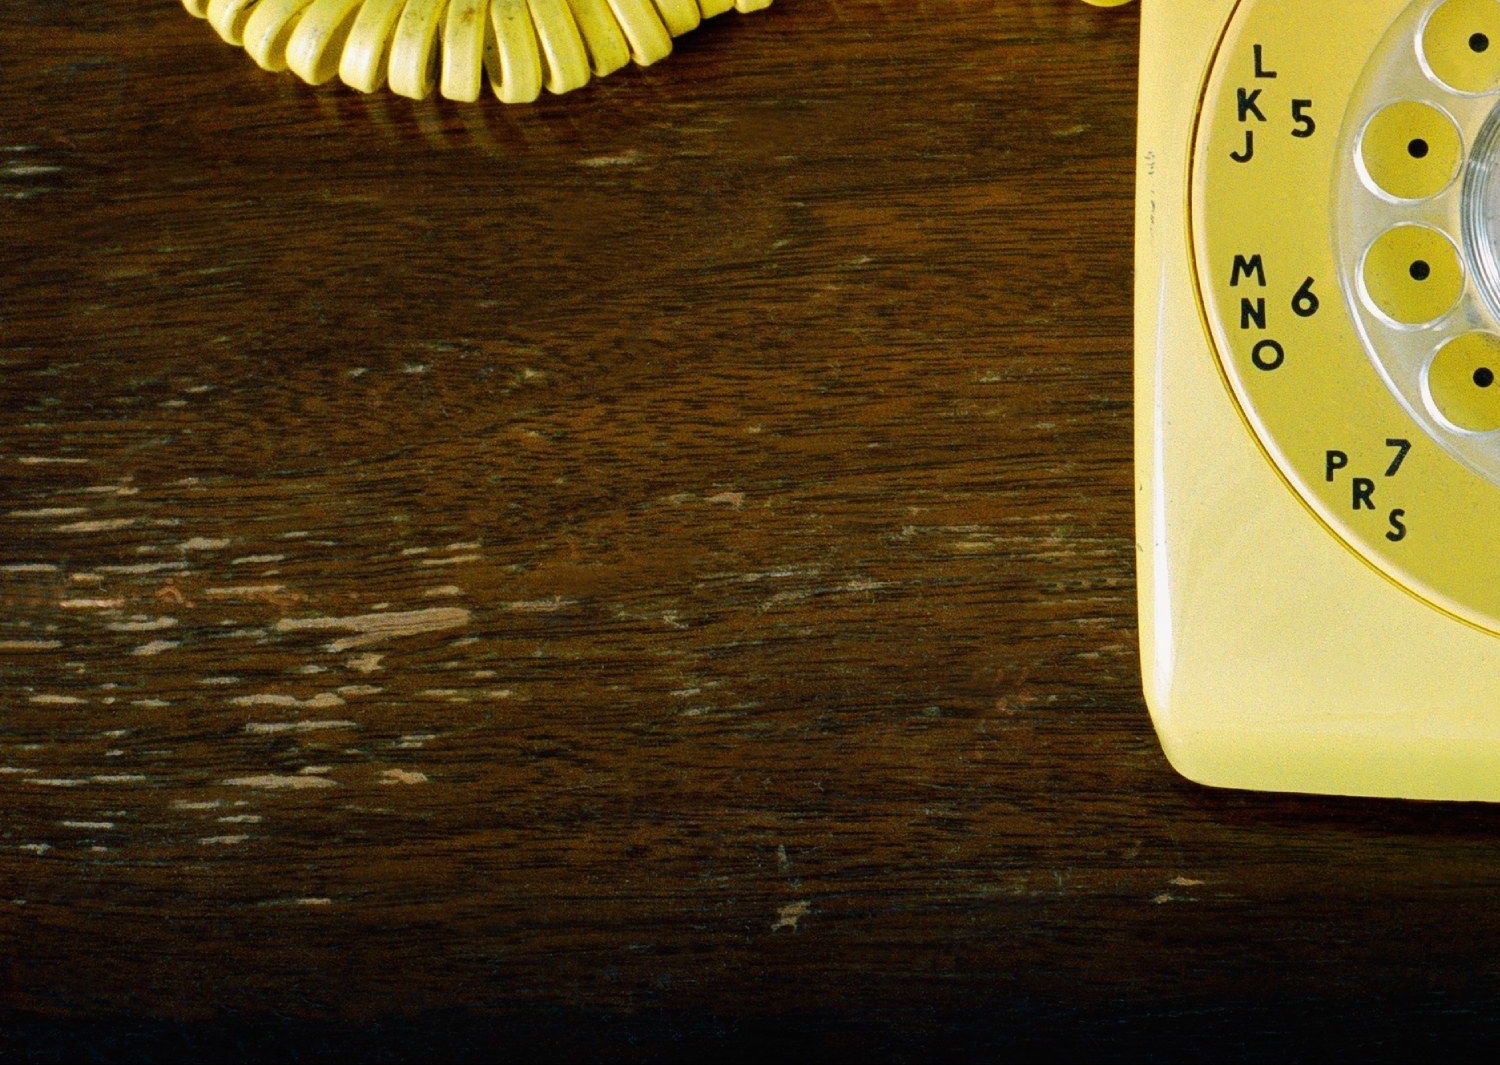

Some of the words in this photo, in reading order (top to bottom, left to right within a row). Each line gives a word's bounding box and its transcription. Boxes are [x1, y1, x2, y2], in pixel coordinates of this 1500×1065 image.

[1291, 99, 1315, 138] 5
[1230, 255, 1284, 371] MNO
[1291, 277, 1319, 317] 6
[1385, 439, 1411, 476] 7
[1326, 450, 1406, 541] PRS
